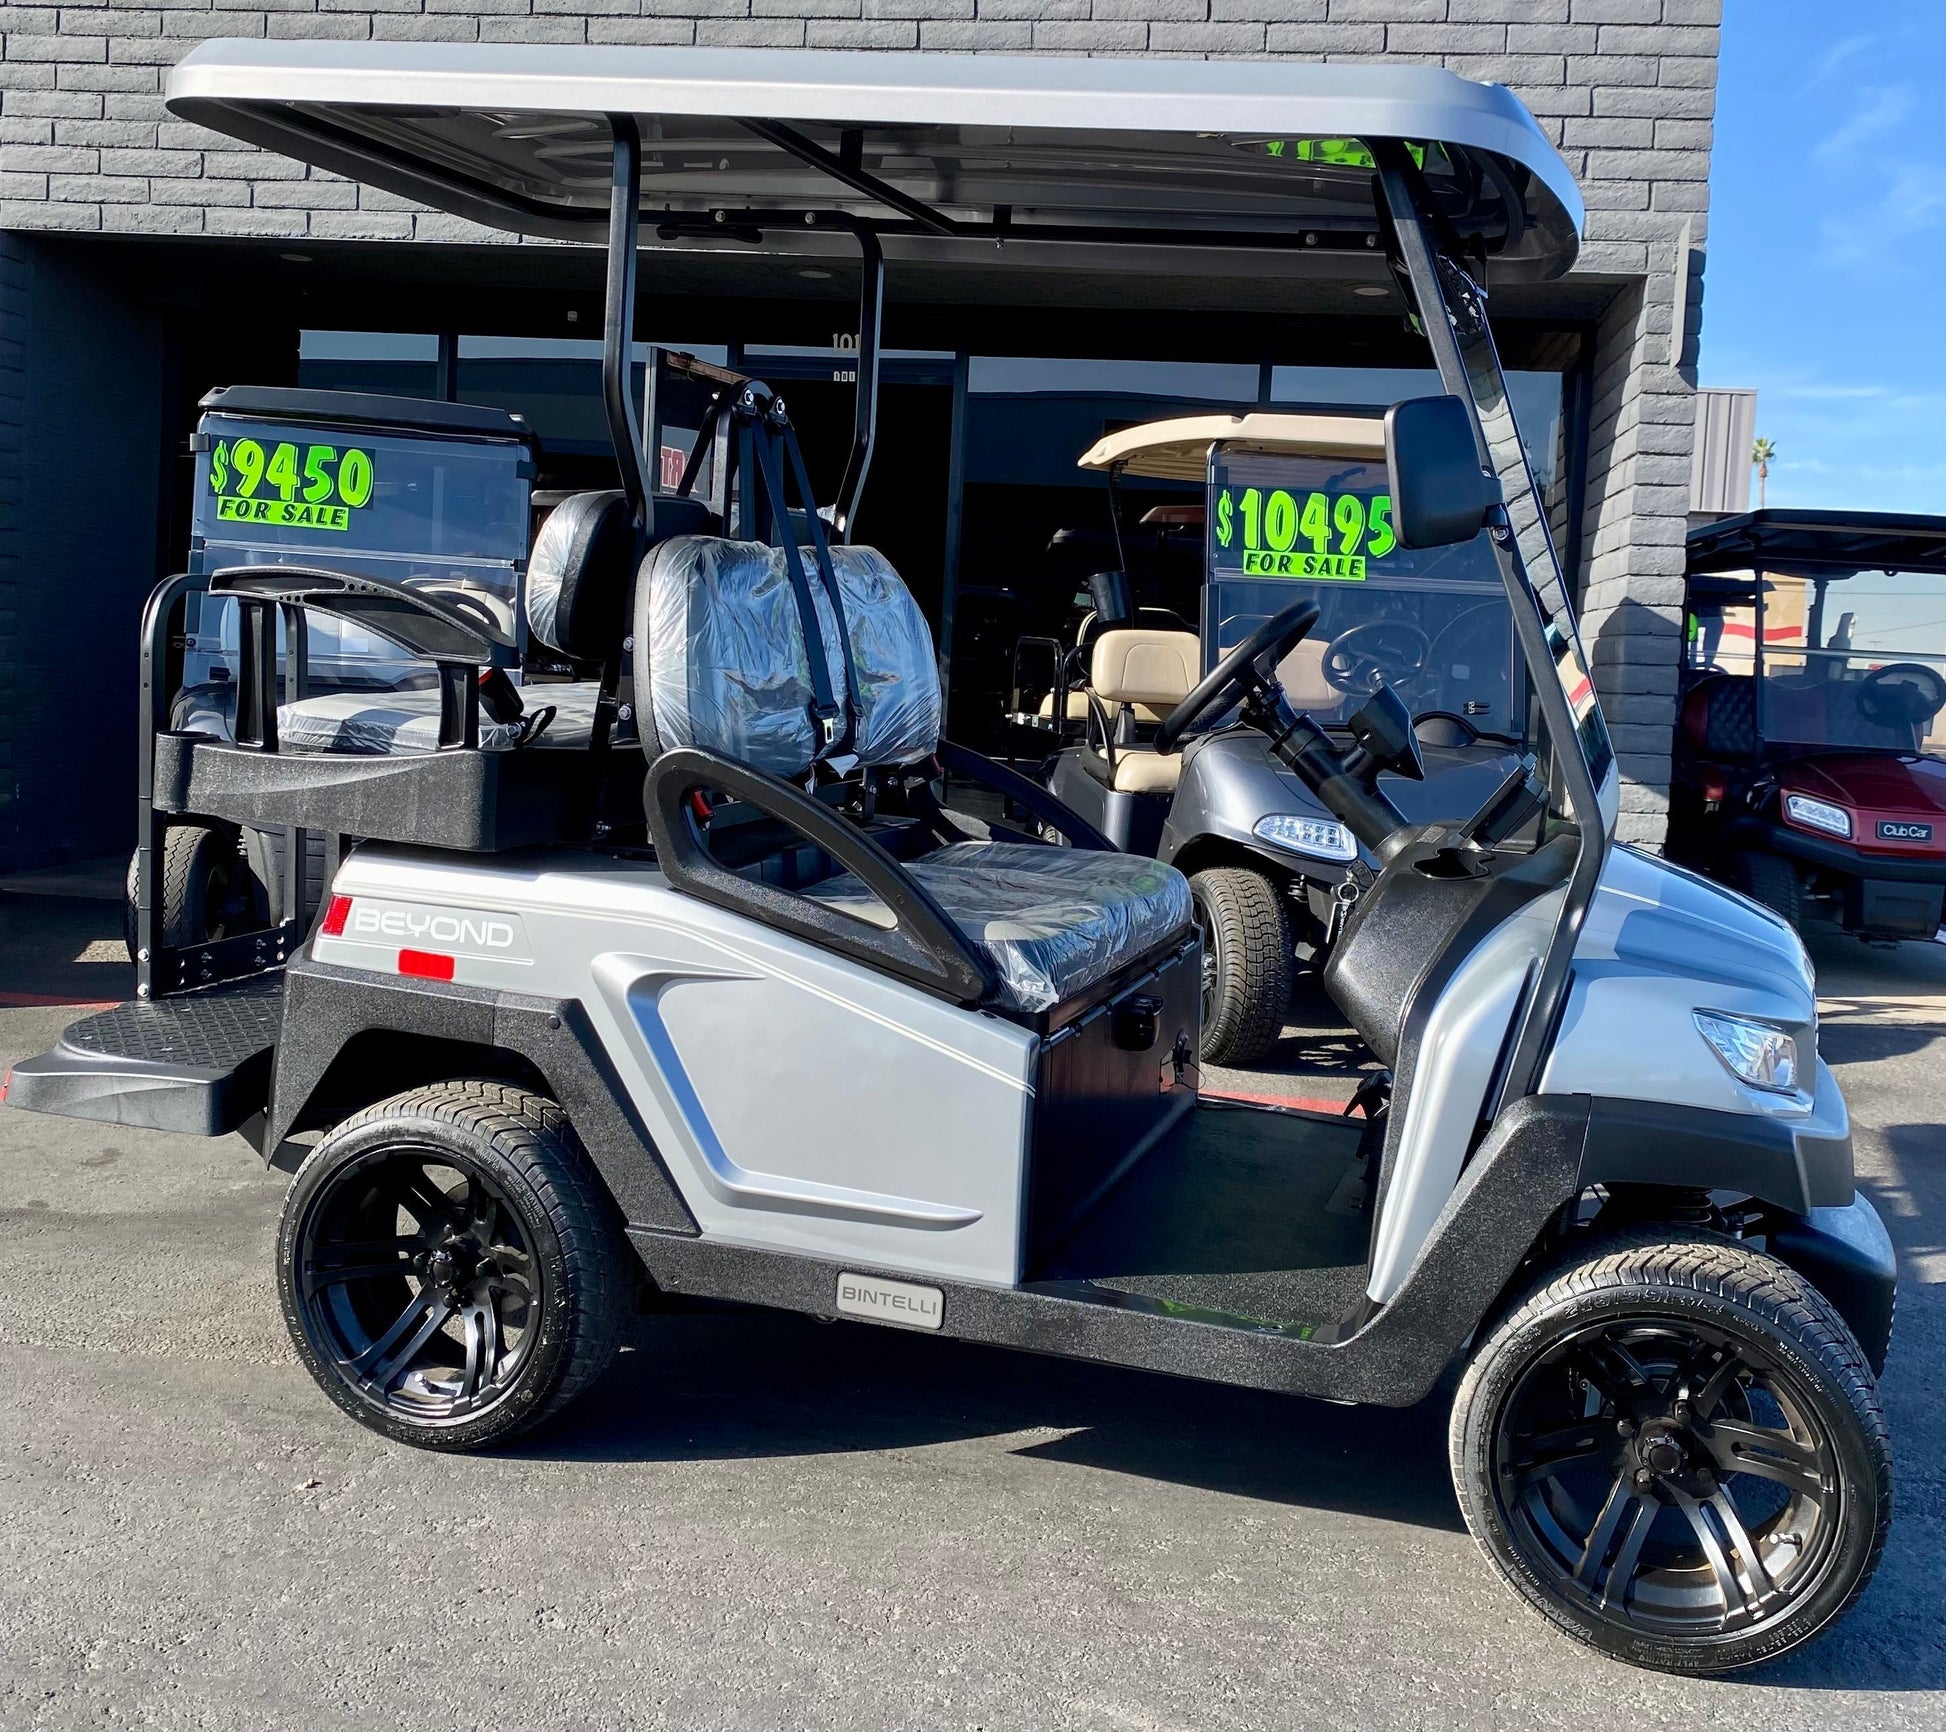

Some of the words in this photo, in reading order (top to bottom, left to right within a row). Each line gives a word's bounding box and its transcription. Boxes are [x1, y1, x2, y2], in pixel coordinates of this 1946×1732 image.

[832, 333, 861, 353] 101
[210, 438, 374, 508] $9450
[219, 499, 271, 520] FOR
[281, 503, 346, 527] SALE
[1216, 488, 1396, 558] $10495
[1245, 553, 1293, 574] FOR
[1303, 555, 1362, 577] SALE
[1883, 824, 1908, 837] Club
[1908, 826, 1928, 838] Car
[354, 907, 514, 948] BEYOND
[842, 1286, 937, 1315] BINTELLI
